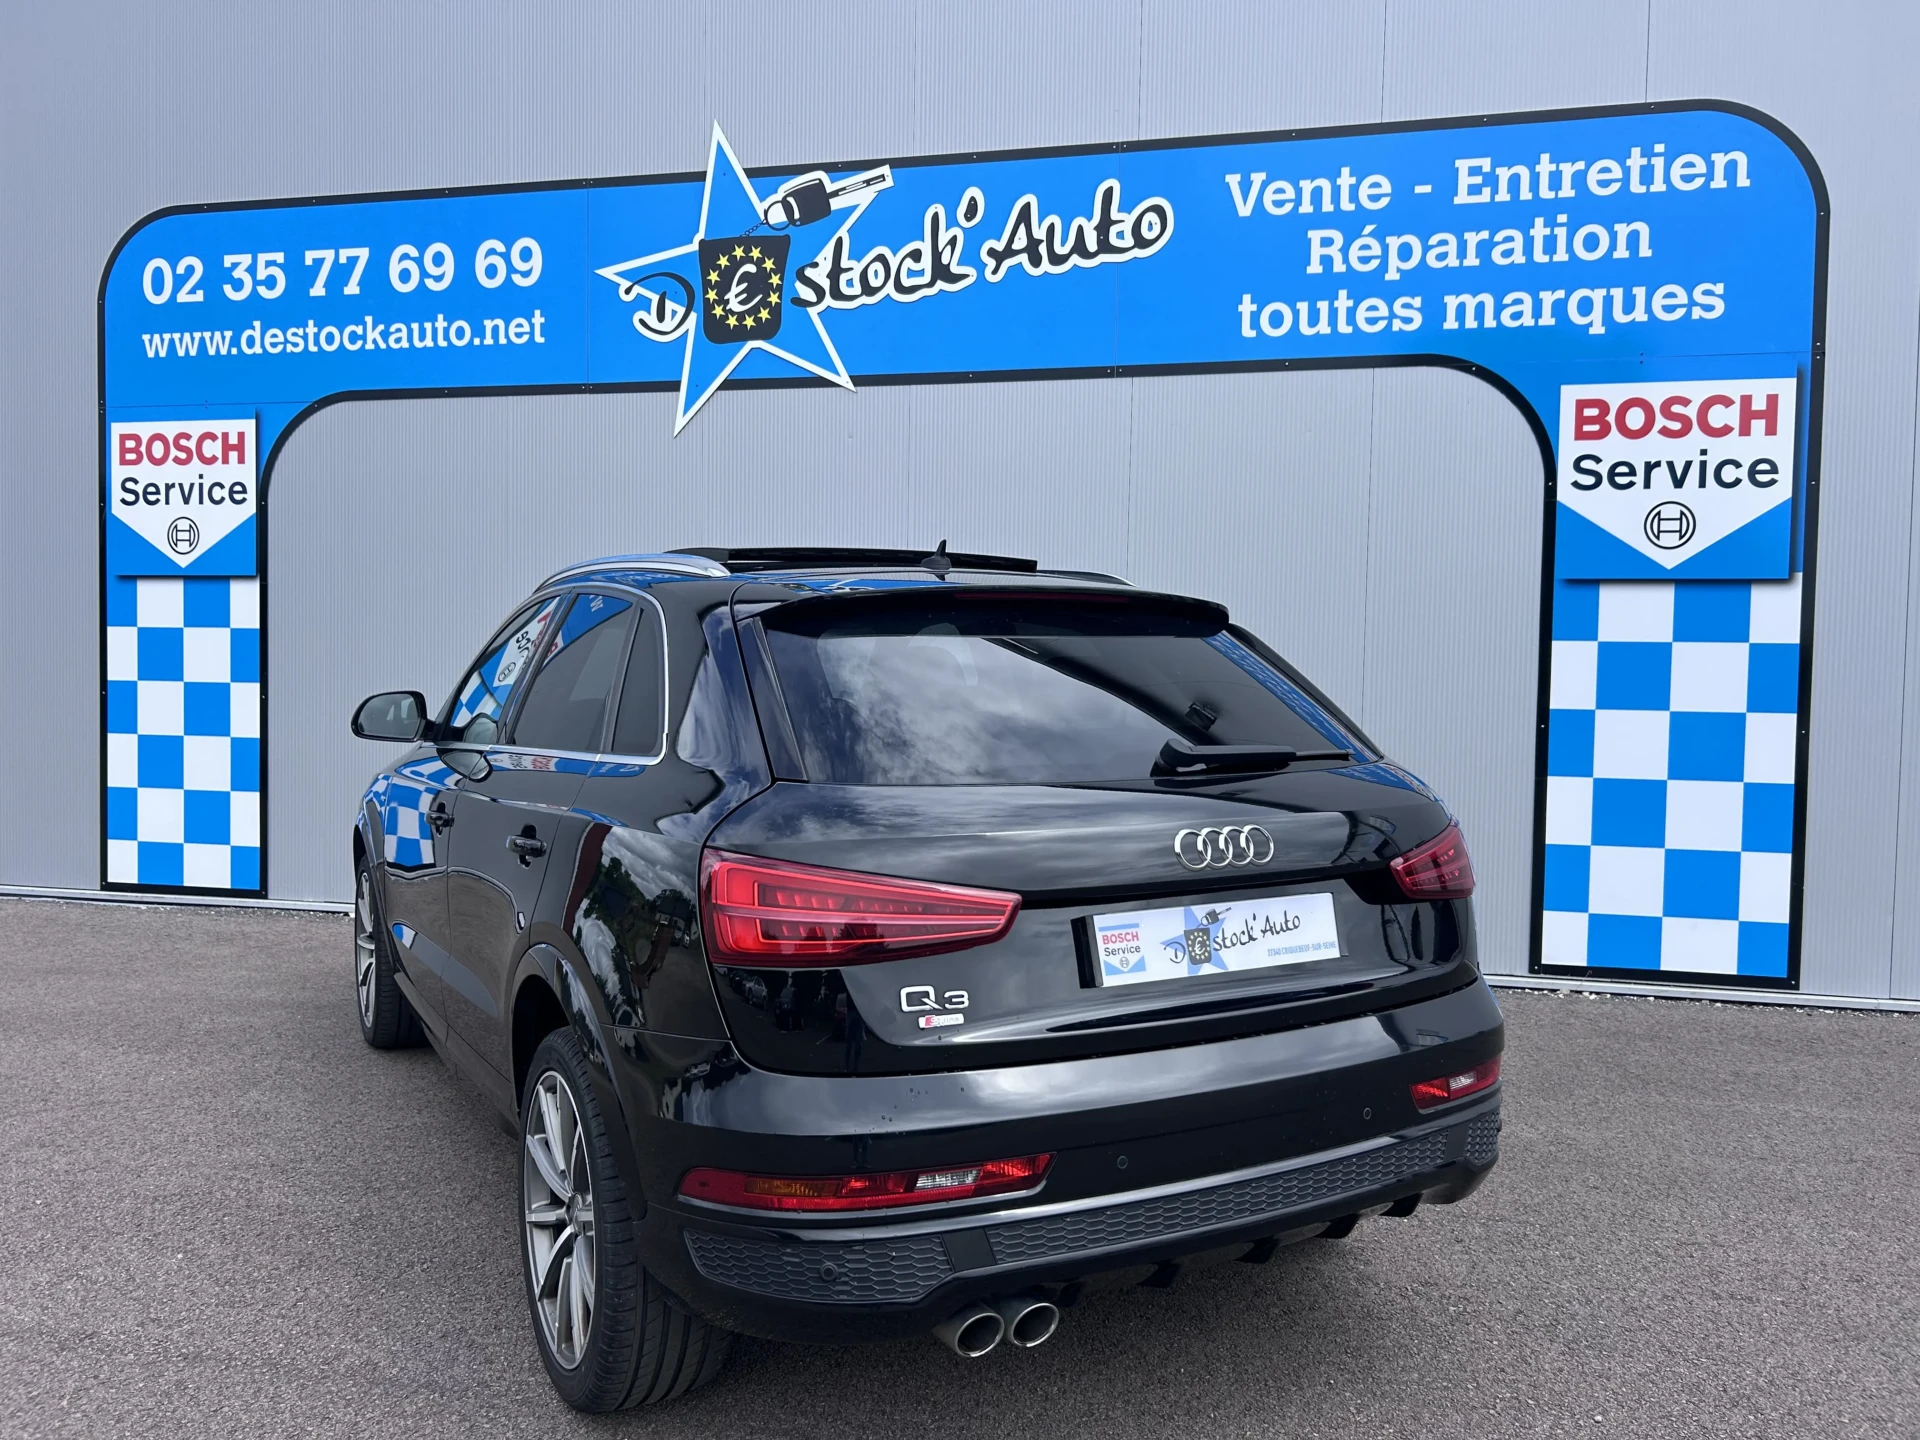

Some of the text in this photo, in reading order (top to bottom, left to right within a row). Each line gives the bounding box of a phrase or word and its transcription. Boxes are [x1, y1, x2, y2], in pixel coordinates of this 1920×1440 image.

[1226, 167, 1391, 216] Vente
[1454, 144, 1751, 205] Entretien
[1306, 214, 1652, 280] Réparation
[142, 238, 543, 304] 02 35 77 69 69
[1238, 283, 1726, 338] toutes marques
[142, 310, 545, 358] www.destockauto.net
[1573, 394, 1779, 441] BOSCH
[118, 431, 246, 466] BOSCH
[1570, 449, 1780, 492] Service
[119, 473, 248, 506] Service
[1101, 931, 1140, 945] BOSCH
[1103, 943, 1141, 957] Service
[900, 985, 970, 1012] Q3
